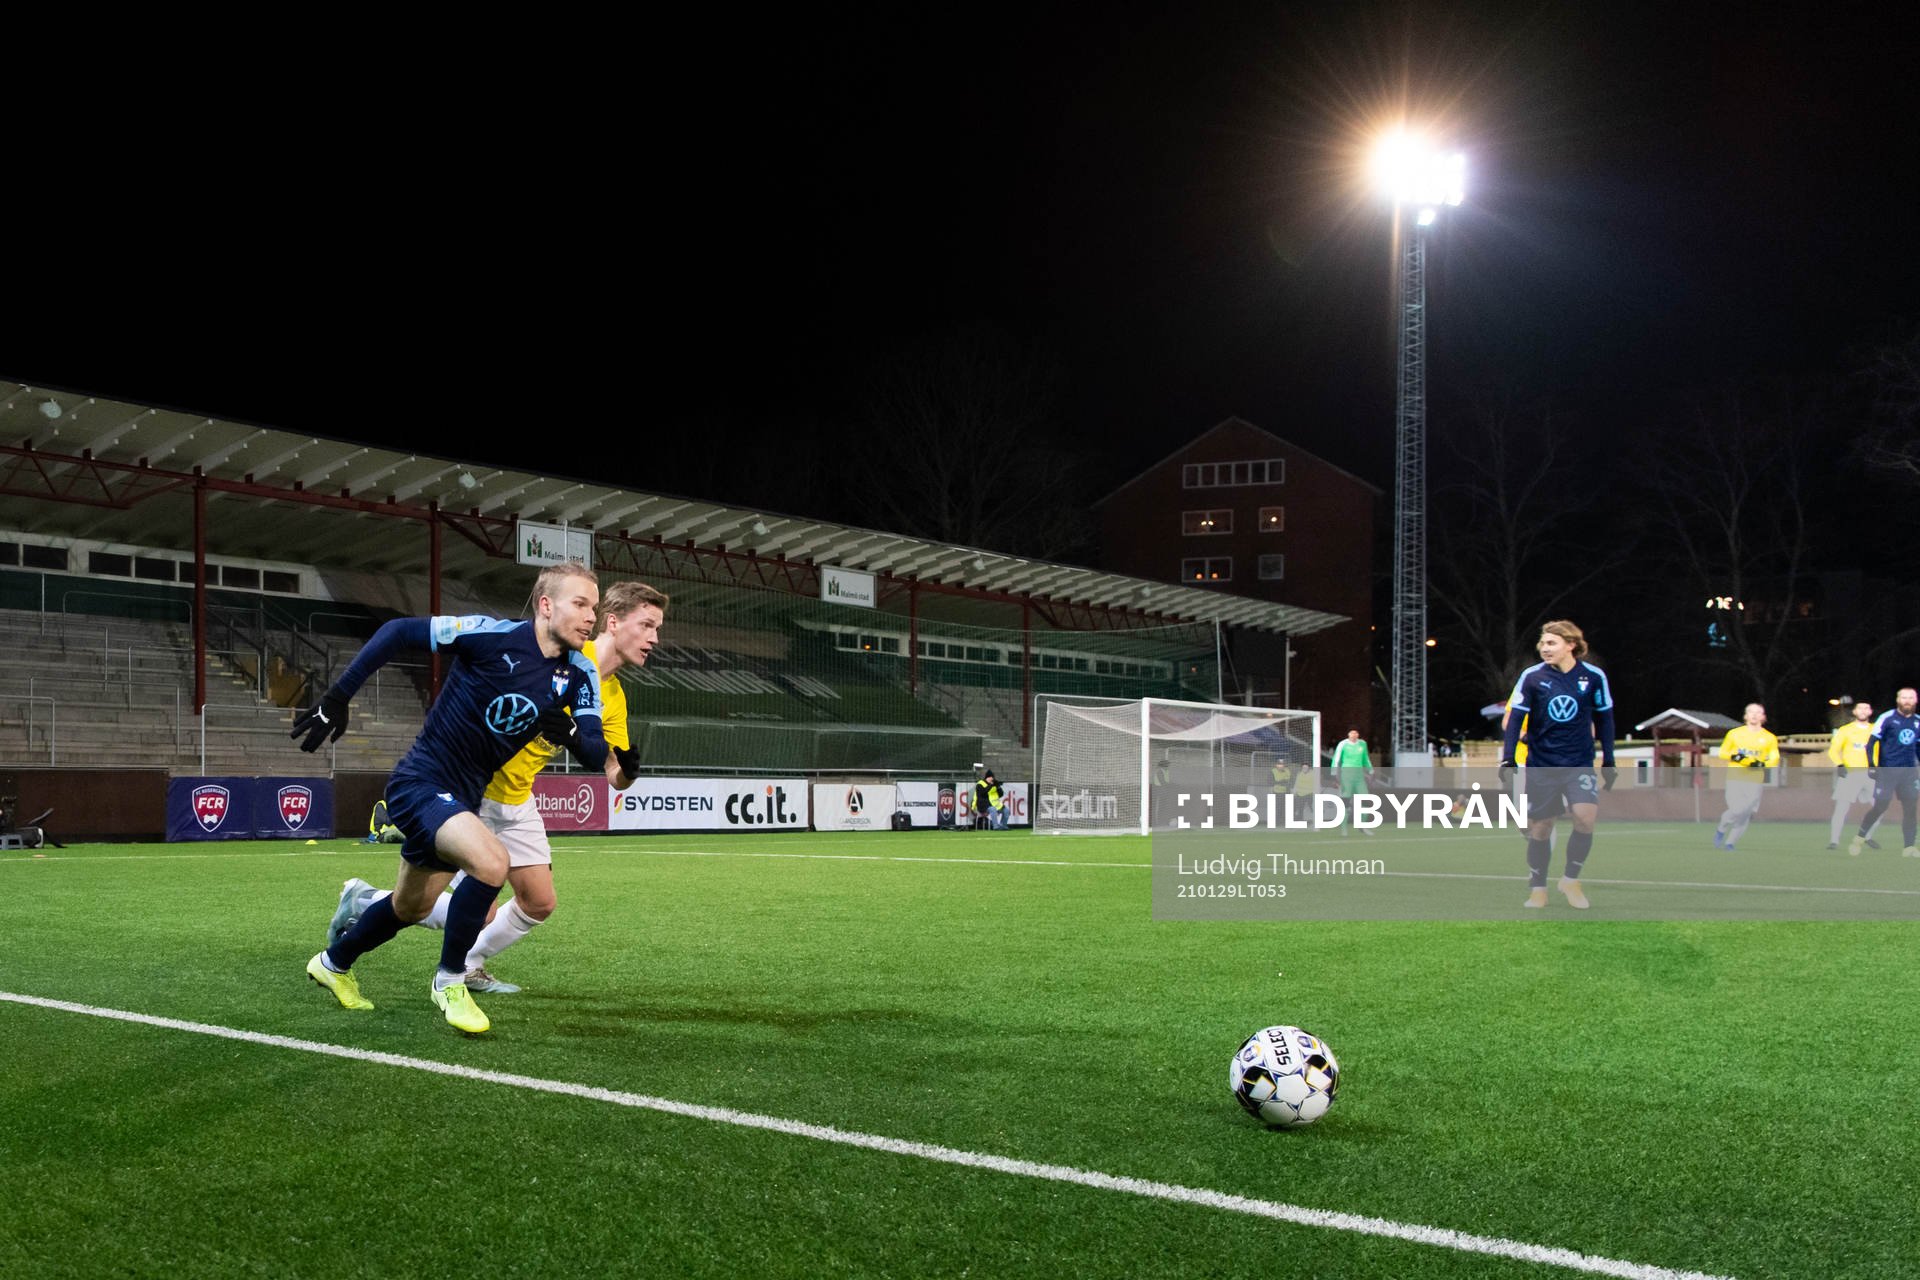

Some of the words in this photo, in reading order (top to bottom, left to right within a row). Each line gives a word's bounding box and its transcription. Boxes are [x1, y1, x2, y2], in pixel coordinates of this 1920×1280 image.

[544, 551, 567, 561] Malm
[198, 797, 225, 809] FCR
[283, 797, 307, 809] FCR
[624, 796, 713, 811] SYDSTEN
[725, 785, 797, 824] cc.it.
